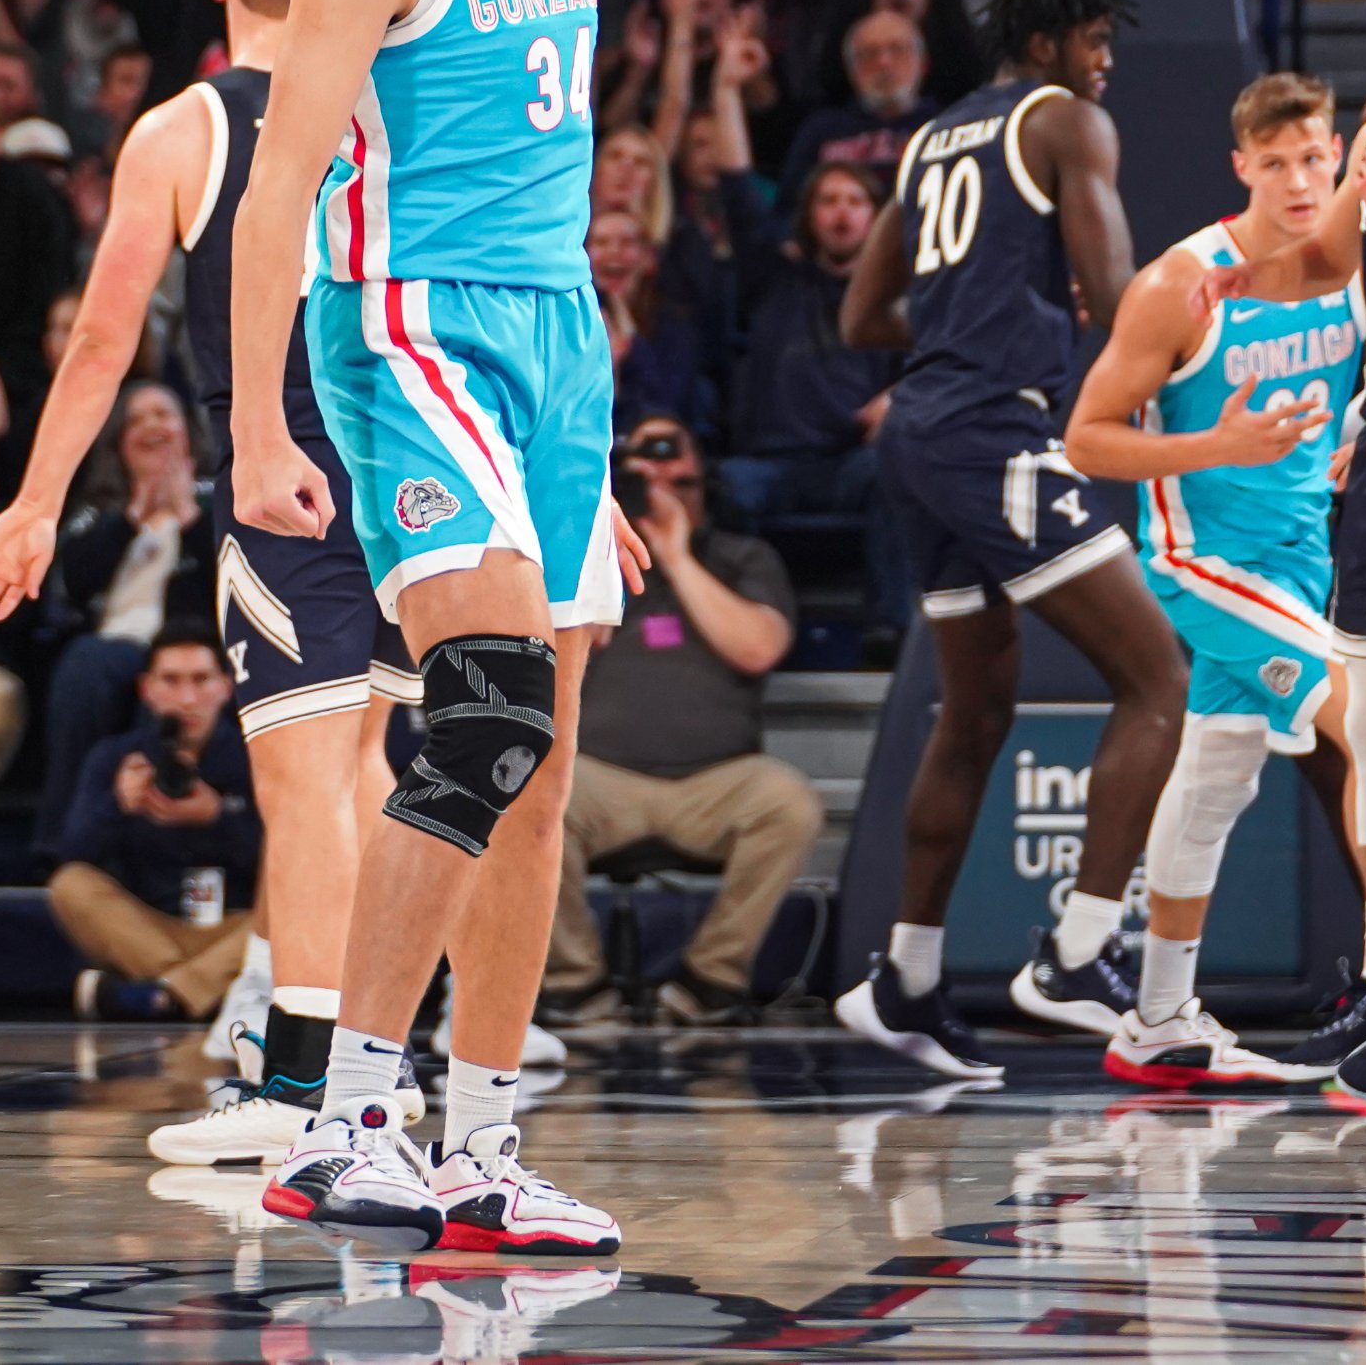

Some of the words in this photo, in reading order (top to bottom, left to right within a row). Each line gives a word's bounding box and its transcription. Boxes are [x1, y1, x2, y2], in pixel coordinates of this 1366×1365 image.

[525, 26, 592, 132] 34
[914, 155, 982, 276] 10
[226, 639, 251, 684] Y
